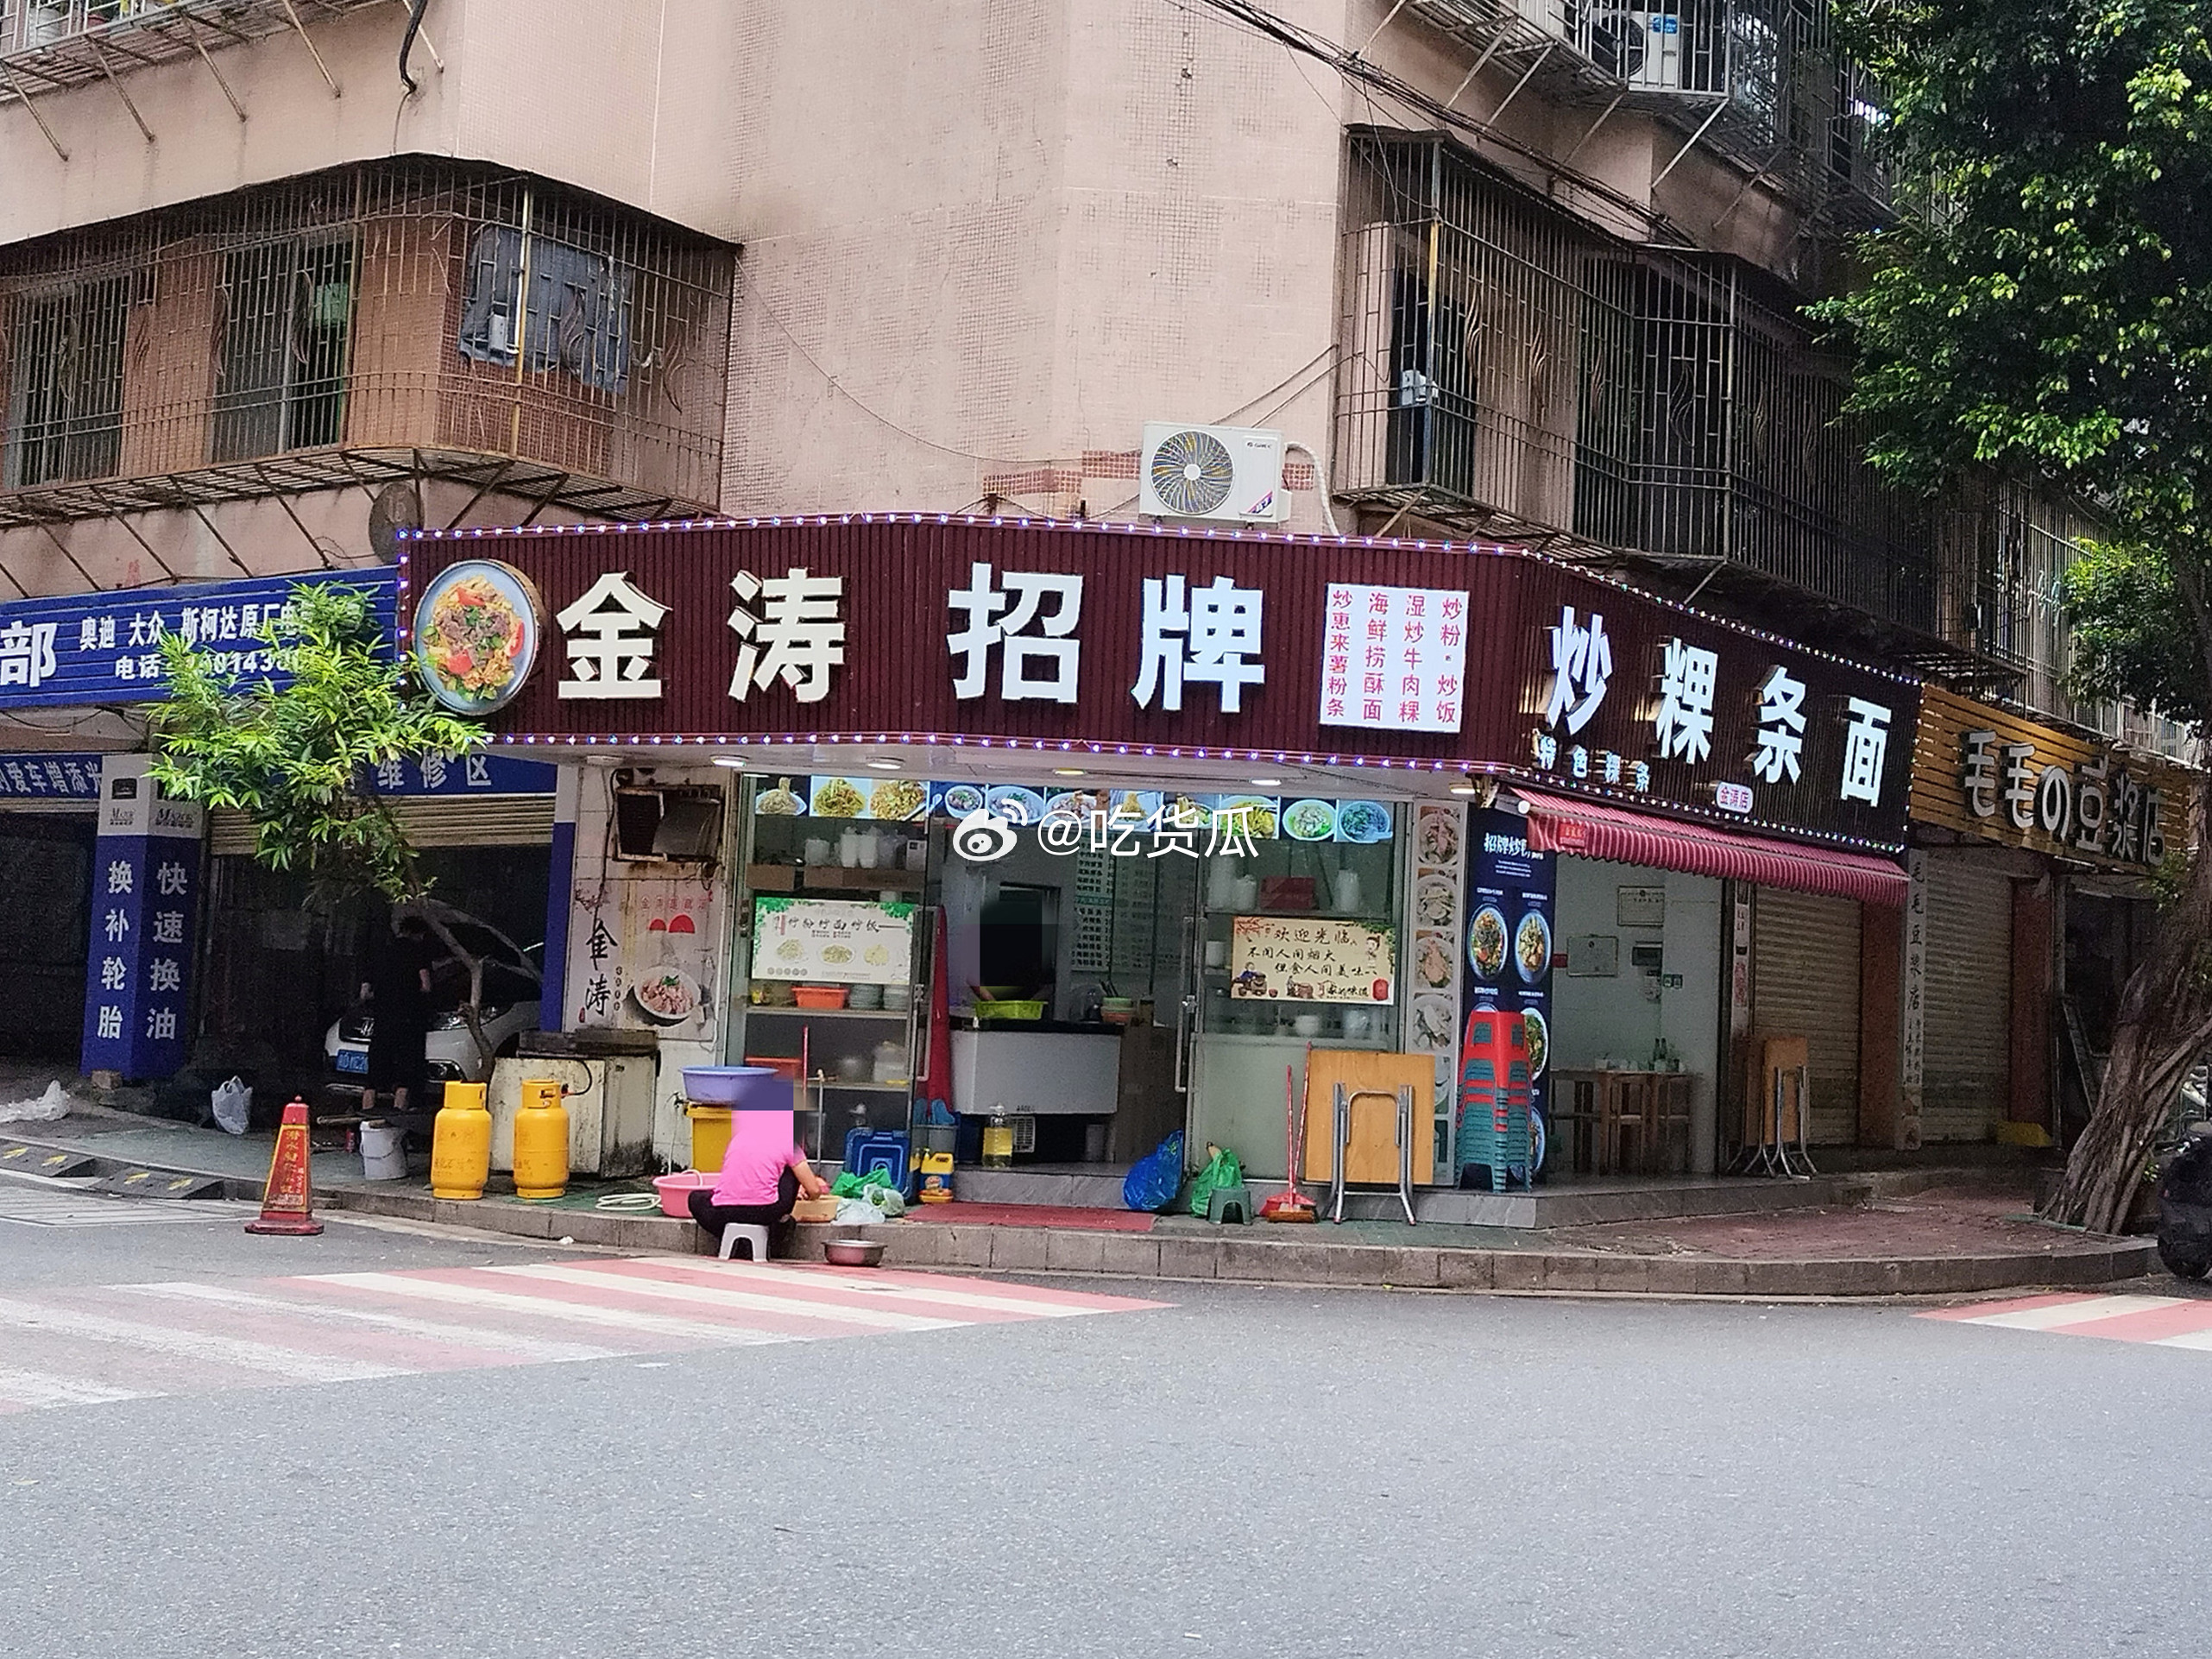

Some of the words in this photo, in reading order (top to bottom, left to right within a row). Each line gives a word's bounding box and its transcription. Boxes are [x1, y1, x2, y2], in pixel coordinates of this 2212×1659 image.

[0, 620, 58, 688] 部
[79, 616, 116, 652] 奥迪
[129, 612, 164, 647] 大众
[556, 562, 1264, 713] 金涛招牌
[1327, 590, 1353, 717] 炒惠来薯粉条
[1363, 592, 1389, 722] 海鲜捞酥面
[1398, 595, 1426, 723] 湿炒牛肉粿
[377, 748, 492, 790] 维修区
[1546, 605, 1892, 808] 炒粿条面
[1964, 729, 2165, 867] 毛毛の豆浆店
[97, 860, 134, 1039] 换补轮胎
[146, 861, 188, 1040] 快速换油
[586, 918, 618, 1017] 金涛
[1274, 926, 1352, 946] 欢迎光临
